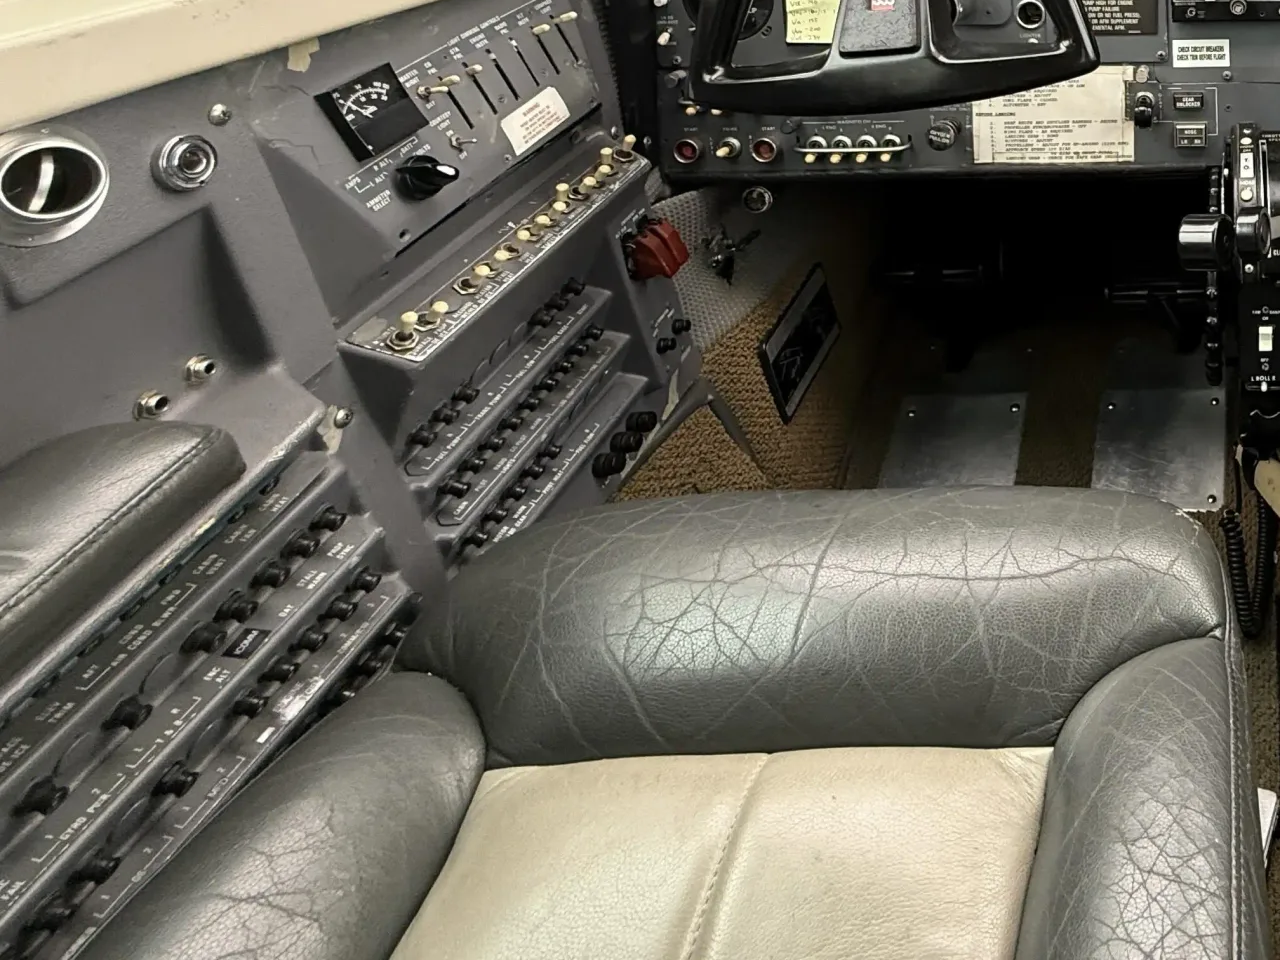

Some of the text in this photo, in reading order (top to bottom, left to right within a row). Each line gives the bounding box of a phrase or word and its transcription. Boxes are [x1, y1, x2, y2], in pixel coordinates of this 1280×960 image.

[447, 34, 461, 47] LIGHT
[479, 15, 500, 30] CONTROLS
[1177, 45, 1225, 53] CHECK CIRCUIT BREAKERS
[1213, 53, 1227, 61] FLIGHT
[429, 110, 452, 127] COURTESY
[400, 143, 414, 155] BATT
[344, 176, 362, 190] AMPS
[365, 189, 391, 209] AMMETER
[372, 198, 391, 212] SELECT
[474, 406, 490, 421] TRANS
[215, 670, 231, 683] ALT
[59, 816, 87, 841] GYRO
